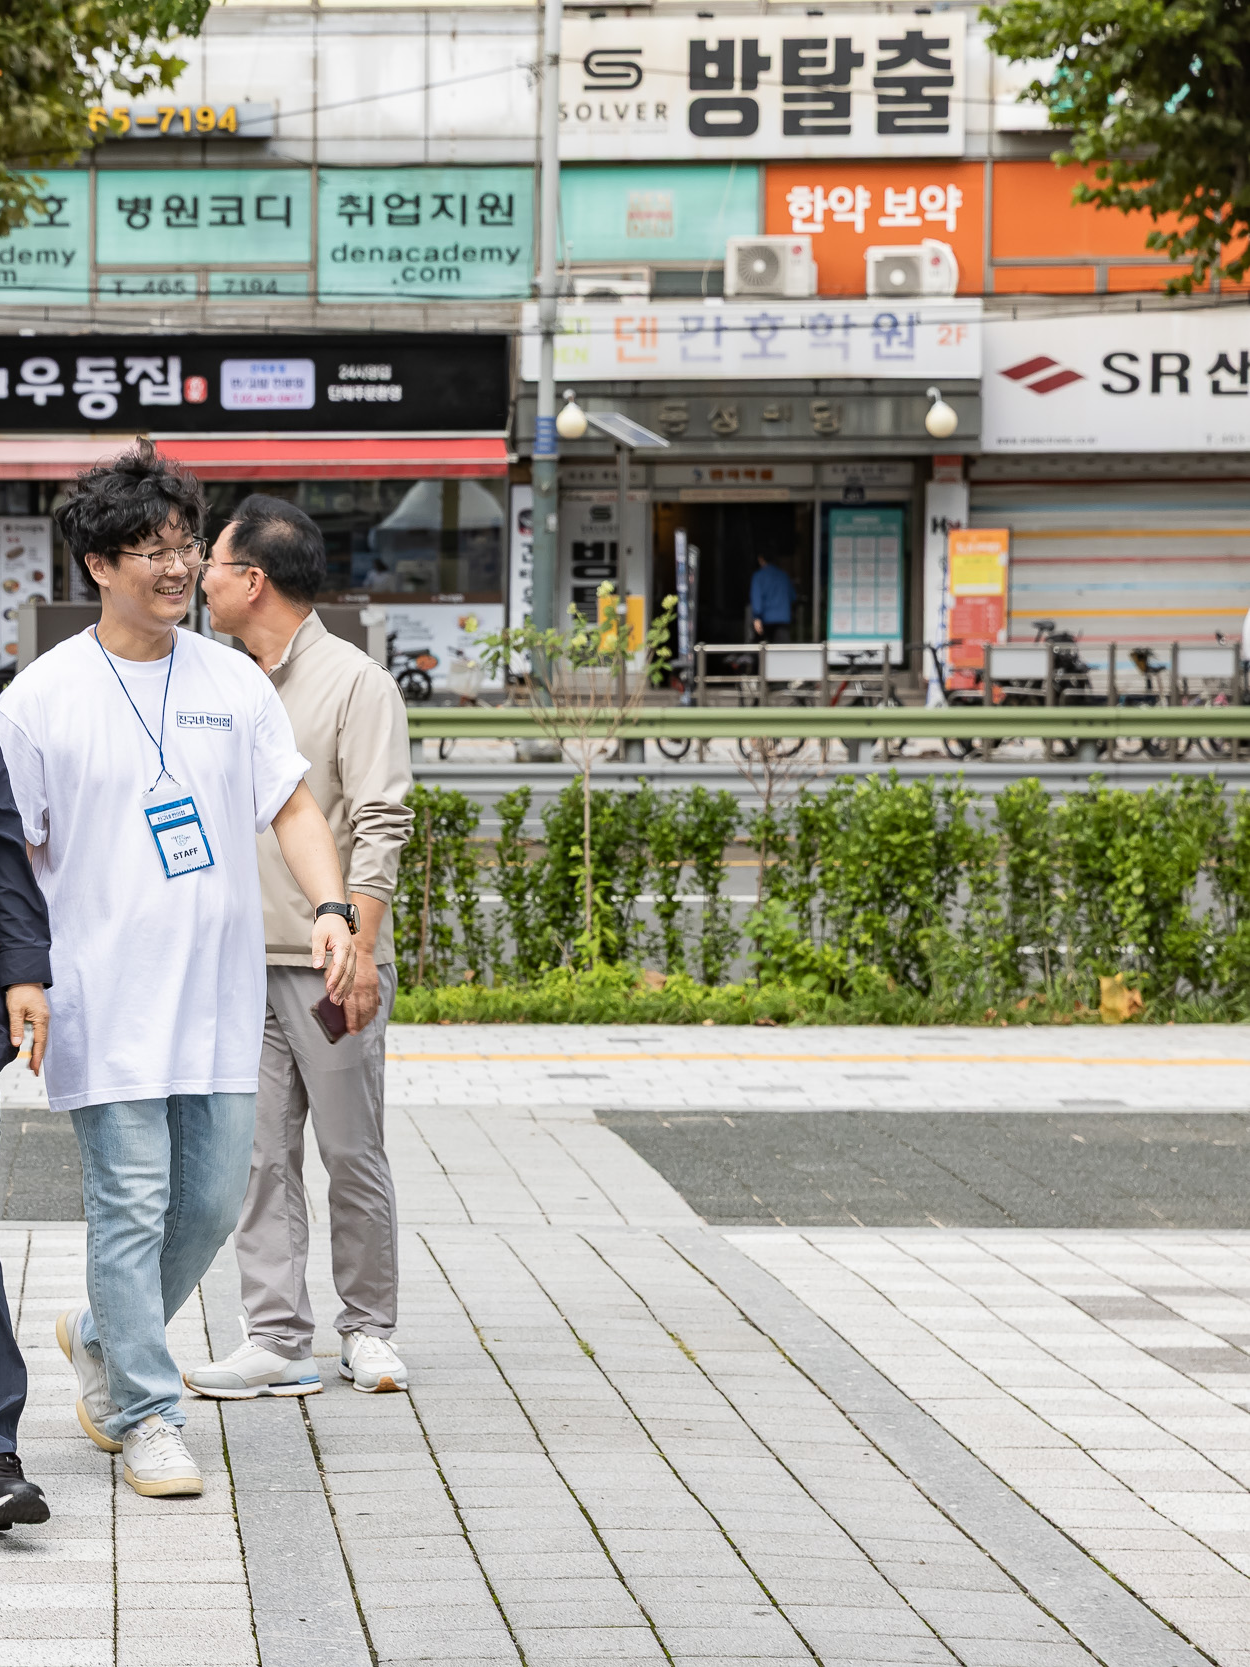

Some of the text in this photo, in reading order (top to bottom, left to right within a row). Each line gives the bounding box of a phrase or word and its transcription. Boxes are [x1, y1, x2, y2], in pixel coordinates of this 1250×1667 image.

[688, 30, 954, 137] 방탈출
[557, 103, 669, 122] SOLVER
[117, 194, 293, 229] 병원코디
[337, 192, 515, 228] 취업지원
[786, 183, 963, 233] 한약 보약
[330, 243, 521, 265] denacademy
[391, 266, 462, 286] .com
[1101, 350, 1250, 396] SR 산
[173, 846, 199, 861] STAFF
